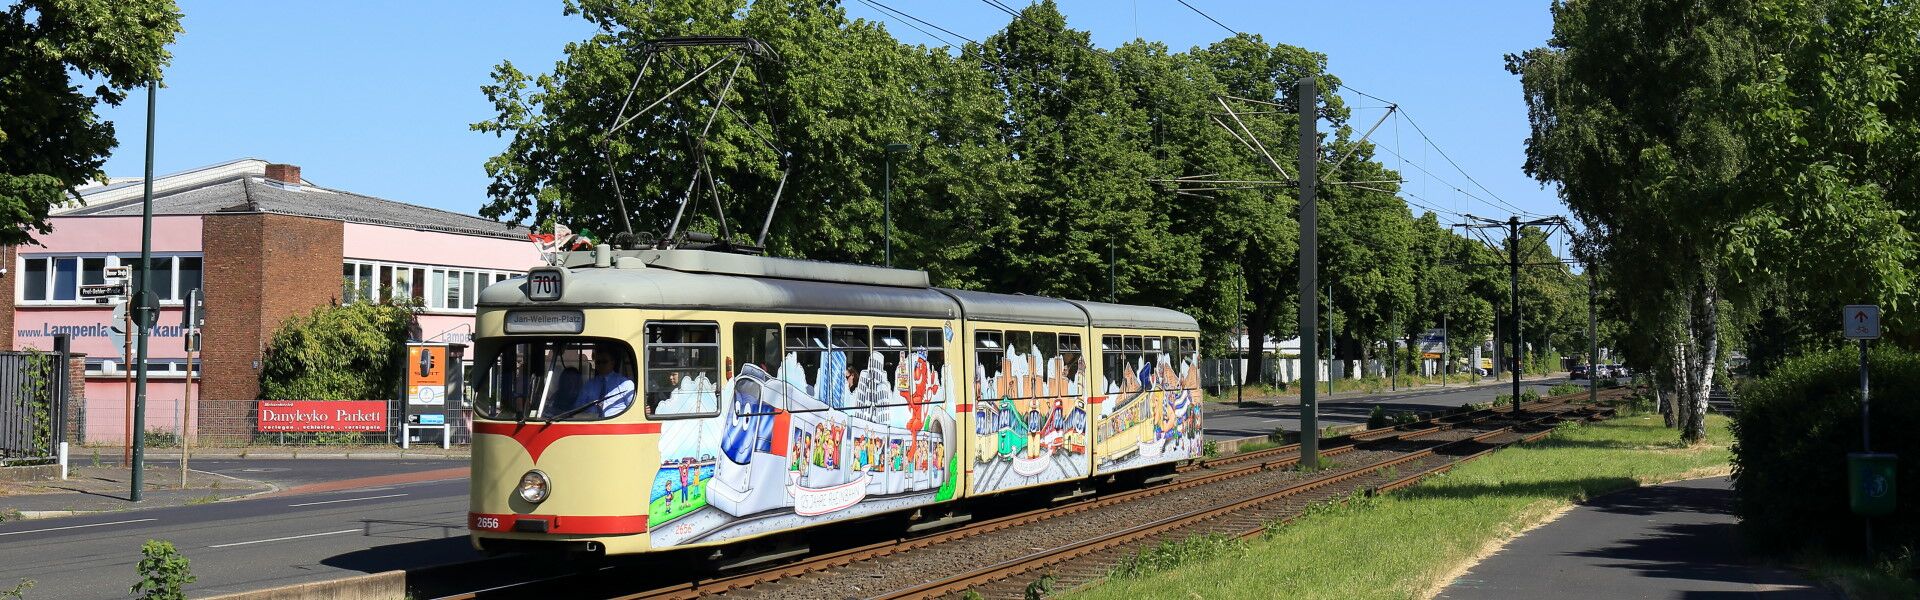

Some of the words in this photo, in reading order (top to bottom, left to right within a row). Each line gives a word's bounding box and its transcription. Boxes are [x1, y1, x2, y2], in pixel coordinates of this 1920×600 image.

[534, 275, 558, 294] 701
[513, 315, 581, 323] Jan-Wellem-Platz
[263, 409, 328, 423] Danyleyko
[336, 409, 380, 422] Parkett
[477, 517, 499, 529] 2656
